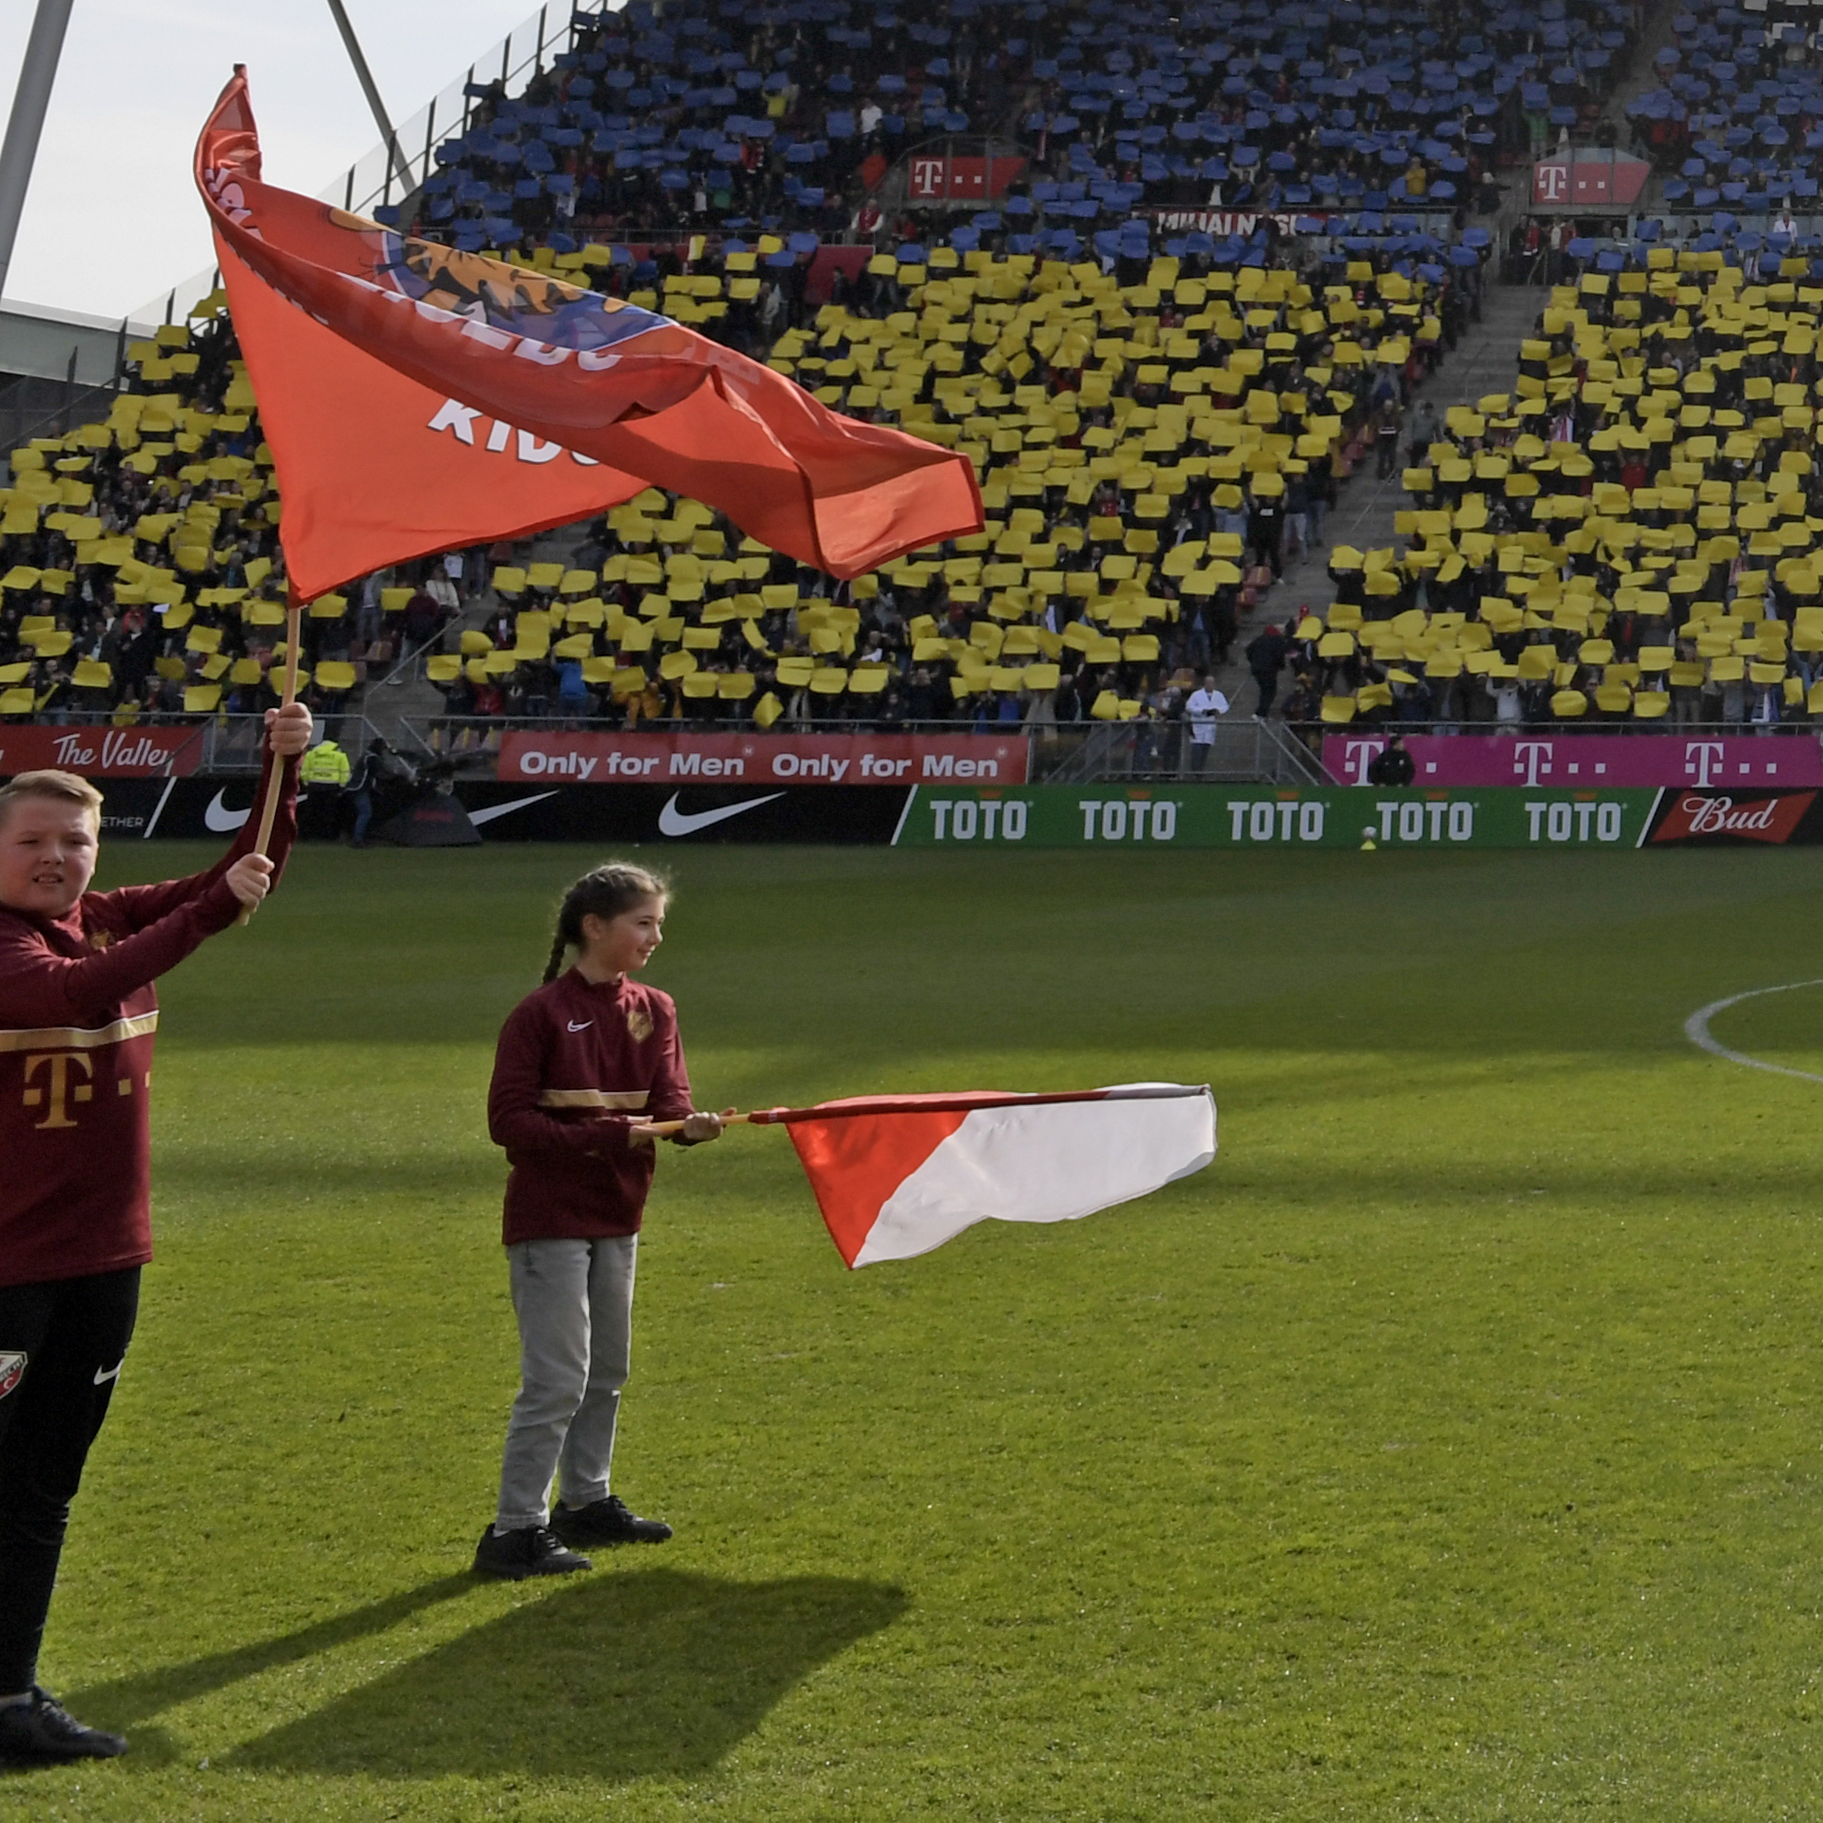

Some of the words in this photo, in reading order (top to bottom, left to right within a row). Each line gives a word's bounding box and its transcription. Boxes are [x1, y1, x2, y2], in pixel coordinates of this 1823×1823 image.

[428, 398, 600, 465] KID
[53, 733, 97, 766] The
[102, 731, 177, 777] Valley
[520, 750, 597, 780] Only
[608, 751, 659, 775] for
[669, 752, 745, 777] Men
[772, 753, 849, 782] Only
[860, 753, 912, 777] for
[922, 754, 998, 778] Men
[930, 800, 1027, 840] TOTO
[1079, 801, 1177, 840] TOTO
[1227, 801, 1324, 841] TOTO
[1376, 801, 1473, 841] TOTO
[1525, 801, 1622, 842] TOTO
[1682, 795, 1778, 833] Bud
